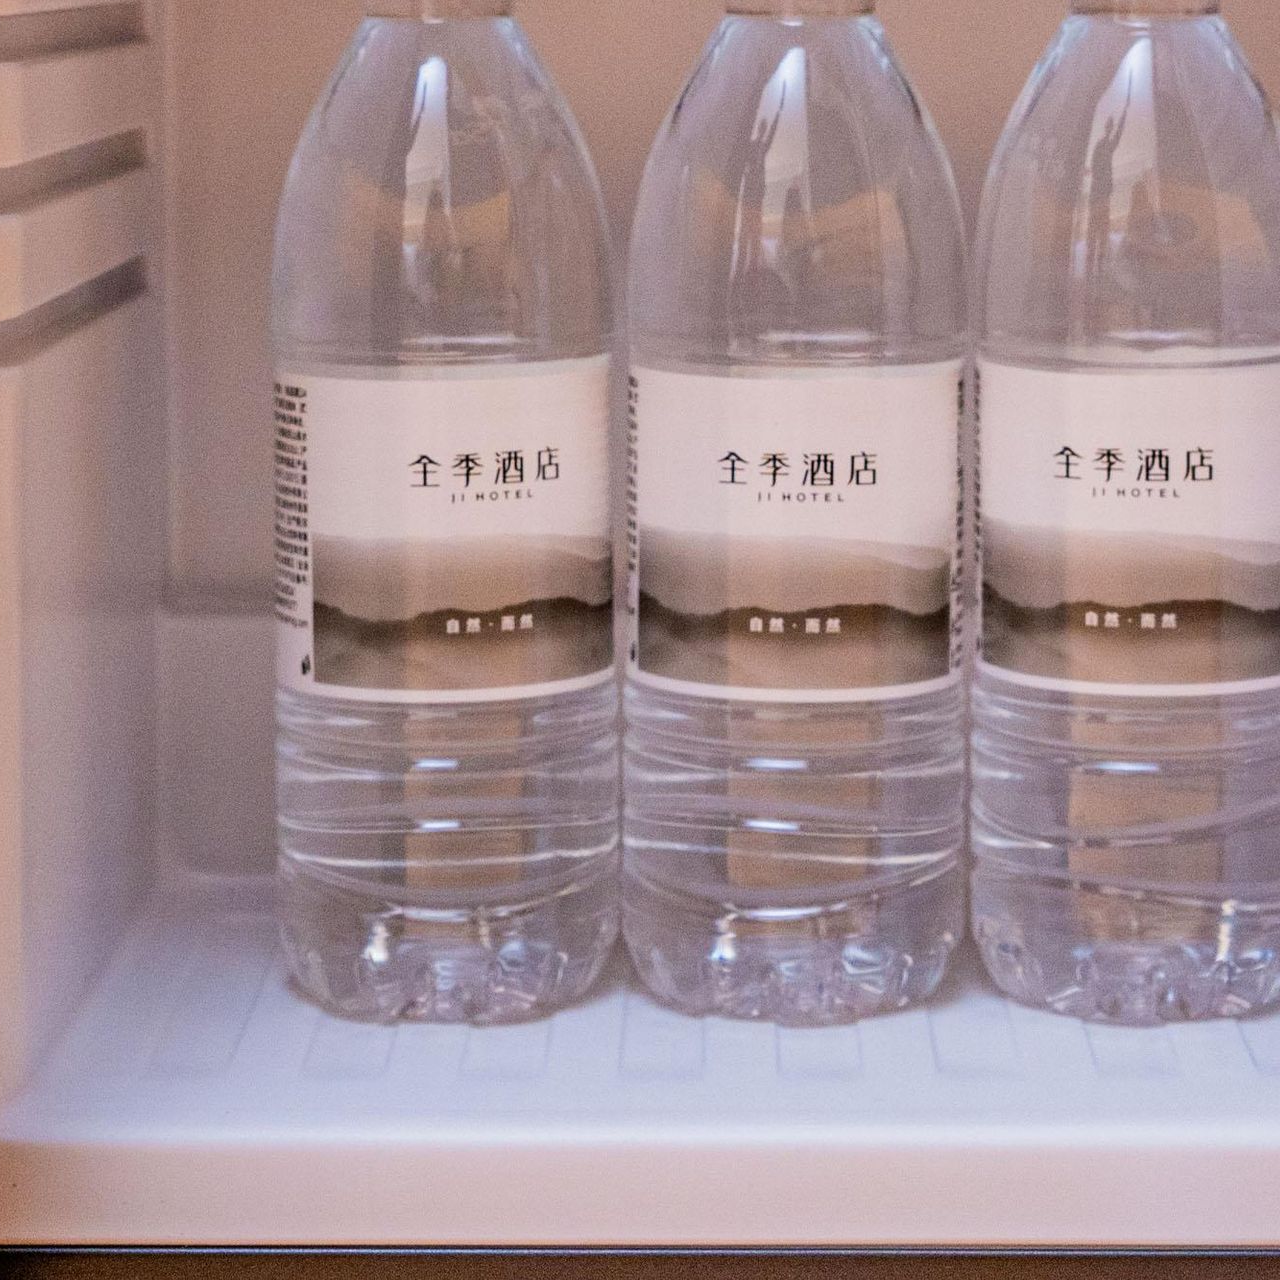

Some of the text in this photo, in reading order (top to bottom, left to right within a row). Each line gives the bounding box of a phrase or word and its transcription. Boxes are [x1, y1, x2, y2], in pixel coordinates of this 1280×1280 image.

[408, 446, 561, 488] 全季酒店
[718, 451, 878, 487] 全季酒店
[1053, 445, 1214, 482] 全季酒店
[475, 488, 534, 502] HOTEL
[757, 491, 845, 503] JI HOTEL
[1116, 487, 1181, 499] HOTEL
